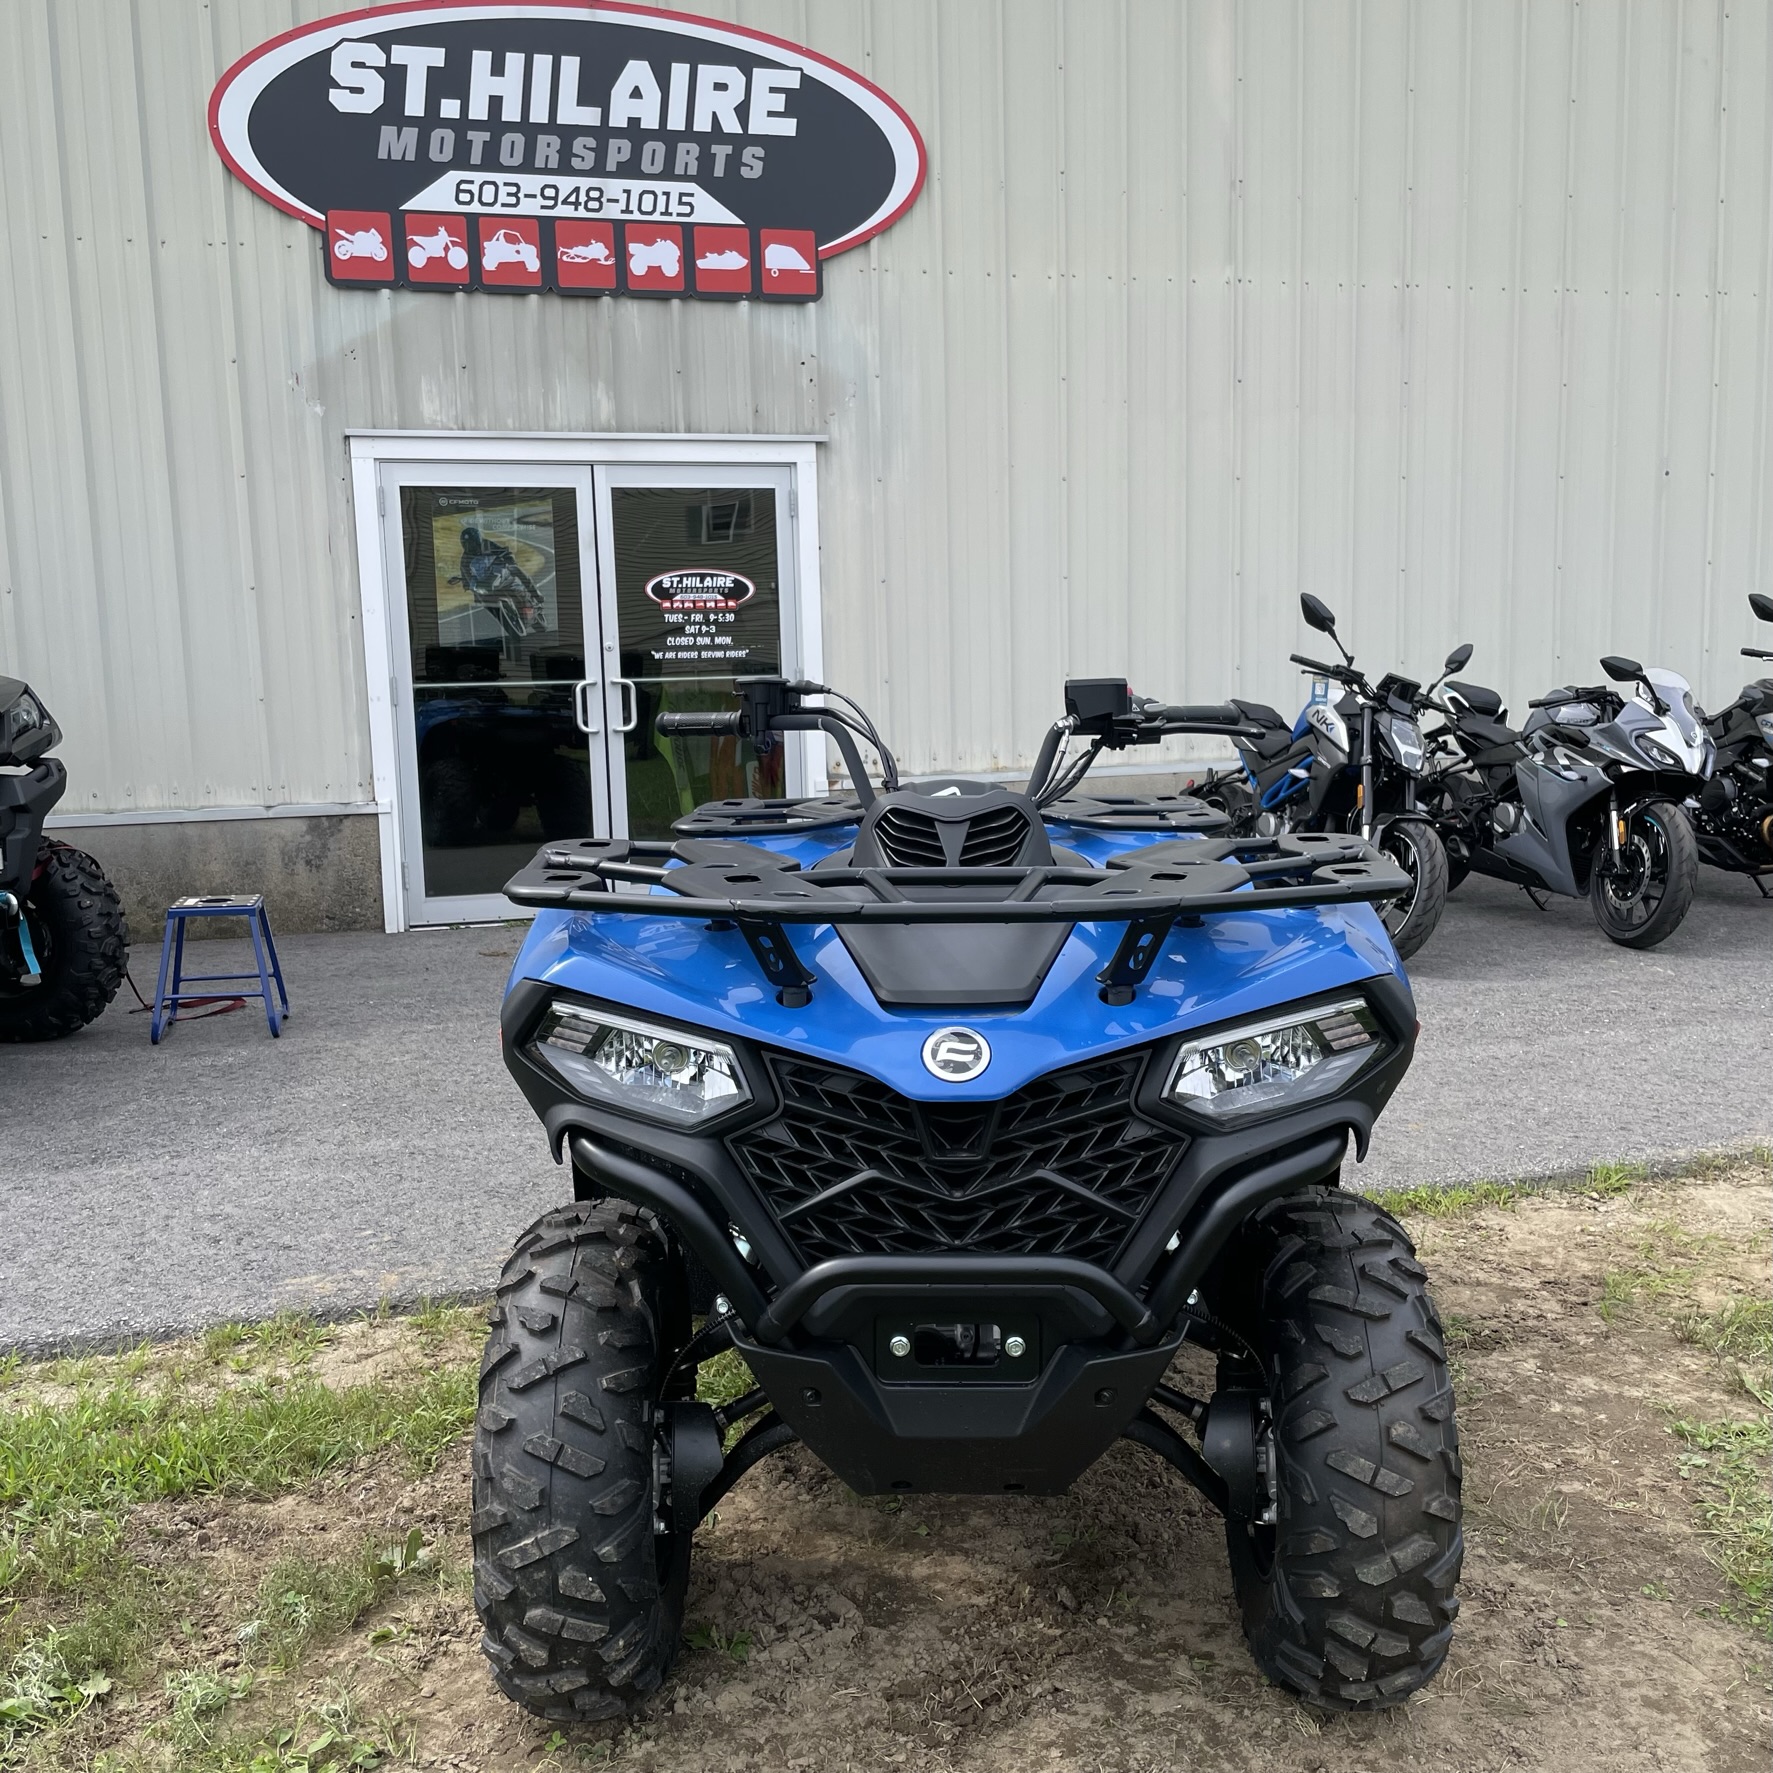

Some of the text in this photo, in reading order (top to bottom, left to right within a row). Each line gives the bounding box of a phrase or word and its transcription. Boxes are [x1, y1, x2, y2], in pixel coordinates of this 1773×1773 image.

[328, 41, 802, 137] ST.HILAIRE
[377, 125, 765, 179] MOTORSPORTS
[454, 179, 696, 218] 603-948-1015
[662, 576, 735, 588] ST.HILAIRE
[690, 614, 706, 623] FRI.
[685, 625, 716, 634] SAT 9-3
[666, 636, 734, 646] CLOSED SUN. MON.
[664, 651, 676, 659] ARE
[677, 651, 699, 659] RIDERS
[701, 650, 725, 659] SERVING
[1312, 709, 1335, 733] NK
